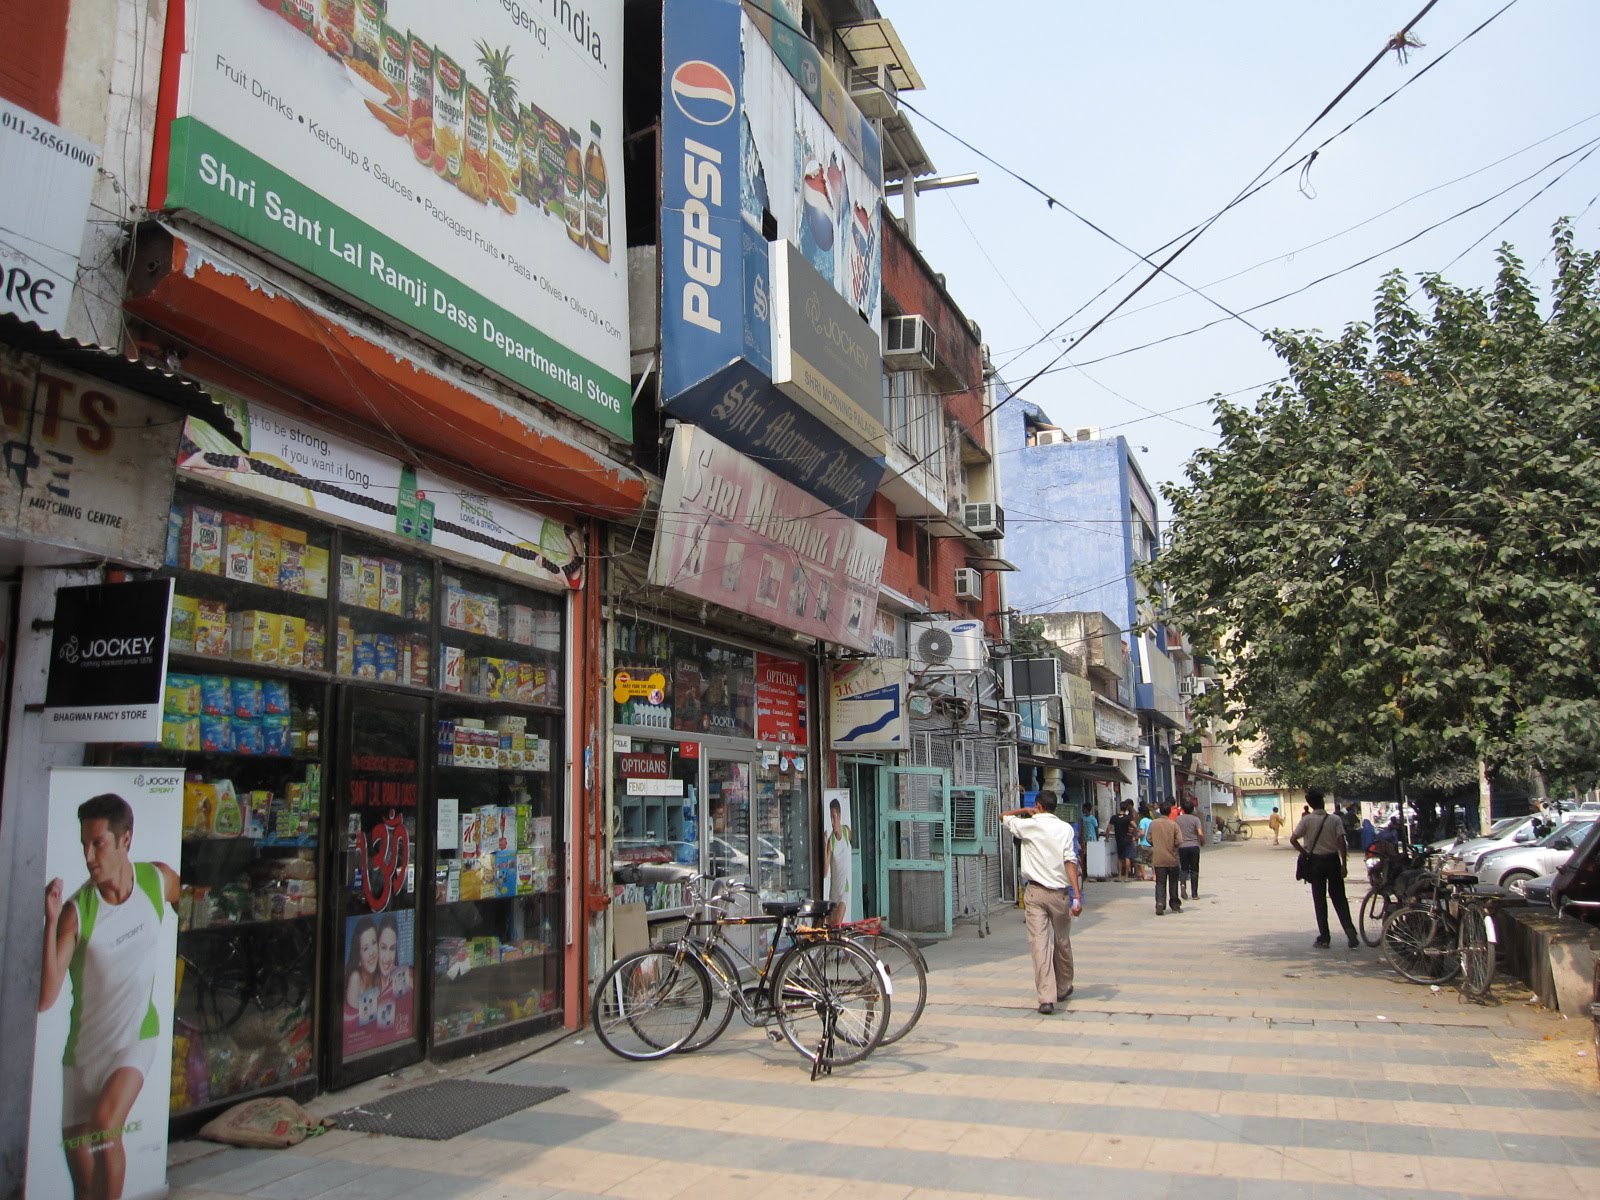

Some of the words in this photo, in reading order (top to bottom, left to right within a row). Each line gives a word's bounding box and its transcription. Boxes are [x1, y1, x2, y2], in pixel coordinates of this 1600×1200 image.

[500, 0, 550, 51] egend.
[383, 57, 405, 81] Corn
[413, 72, 427, 87] Four
[434, 95, 464, 121] Pineapple
[2, 111, 95, 167] 011-26561000
[467, 127, 488, 146] Orange
[492, 139, 519, 160] Pineapple
[215, 54, 248, 89] Fruit
[251, 76, 294, 121] Drinks
[308, 116, 360, 166] Ketchup
[361, 154, 371, 172] &
[373, 163, 413, 202] Sauces
[424, 198, 473, 243] Packaged
[474, 228, 499, 259] Fruits
[508, 254, 532, 281] Pasta
[539, 275, 563, 302] Olives
[570, 296, 588, 319] Olive
[588, 305, 599, 327] Oil
[682, 138, 722, 334] PEPSI
[199, 153, 256, 208] Shri
[264, 190, 322, 247] Sant
[329, 226, 363, 268] Lal
[370, 251, 428, 307] Ramji
[434, 287, 478, 334] Dass
[483, 318, 584, 395] Departmental
[586, 378, 621, 414] Store
[823, 317, 870, 372] JOCKEY
[710, 378, 773, 436] Shri
[804, 370, 822, 397] SHRI
[822, 383, 853, 421] MORNING
[853, 411, 877, 438] PALACE
[241, 412, 259, 427] got
[261, 419, 272, 432] to
[274, 421, 287, 437] be
[290, 427, 332, 456] strong,
[281, 443, 289, 458] if
[290, 450, 309, 465] you
[311, 458, 335, 474] want
[336, 463, 343, 475] it
[29, 496, 83, 521] MATCHING
[87, 509, 123, 530] CENTRE
[460, 513, 476, 526] LONG
[481, 519, 502, 534] STRONG
[200, 527, 215, 538] CORN
[82, 636, 154, 658] JOCKEY
[766, 669, 798, 687] OPTICIAN
[53, 712, 92, 722] BHAGWAN
[94, 711, 119, 720] FANCY
[121, 710, 147, 719] STORE
[710, 714, 735, 728] JOCKEY
[621, 758, 667, 773] OPTICIANS
[146, 777, 180, 785] JOCKEY
[115, 922, 144, 946] SPORT
